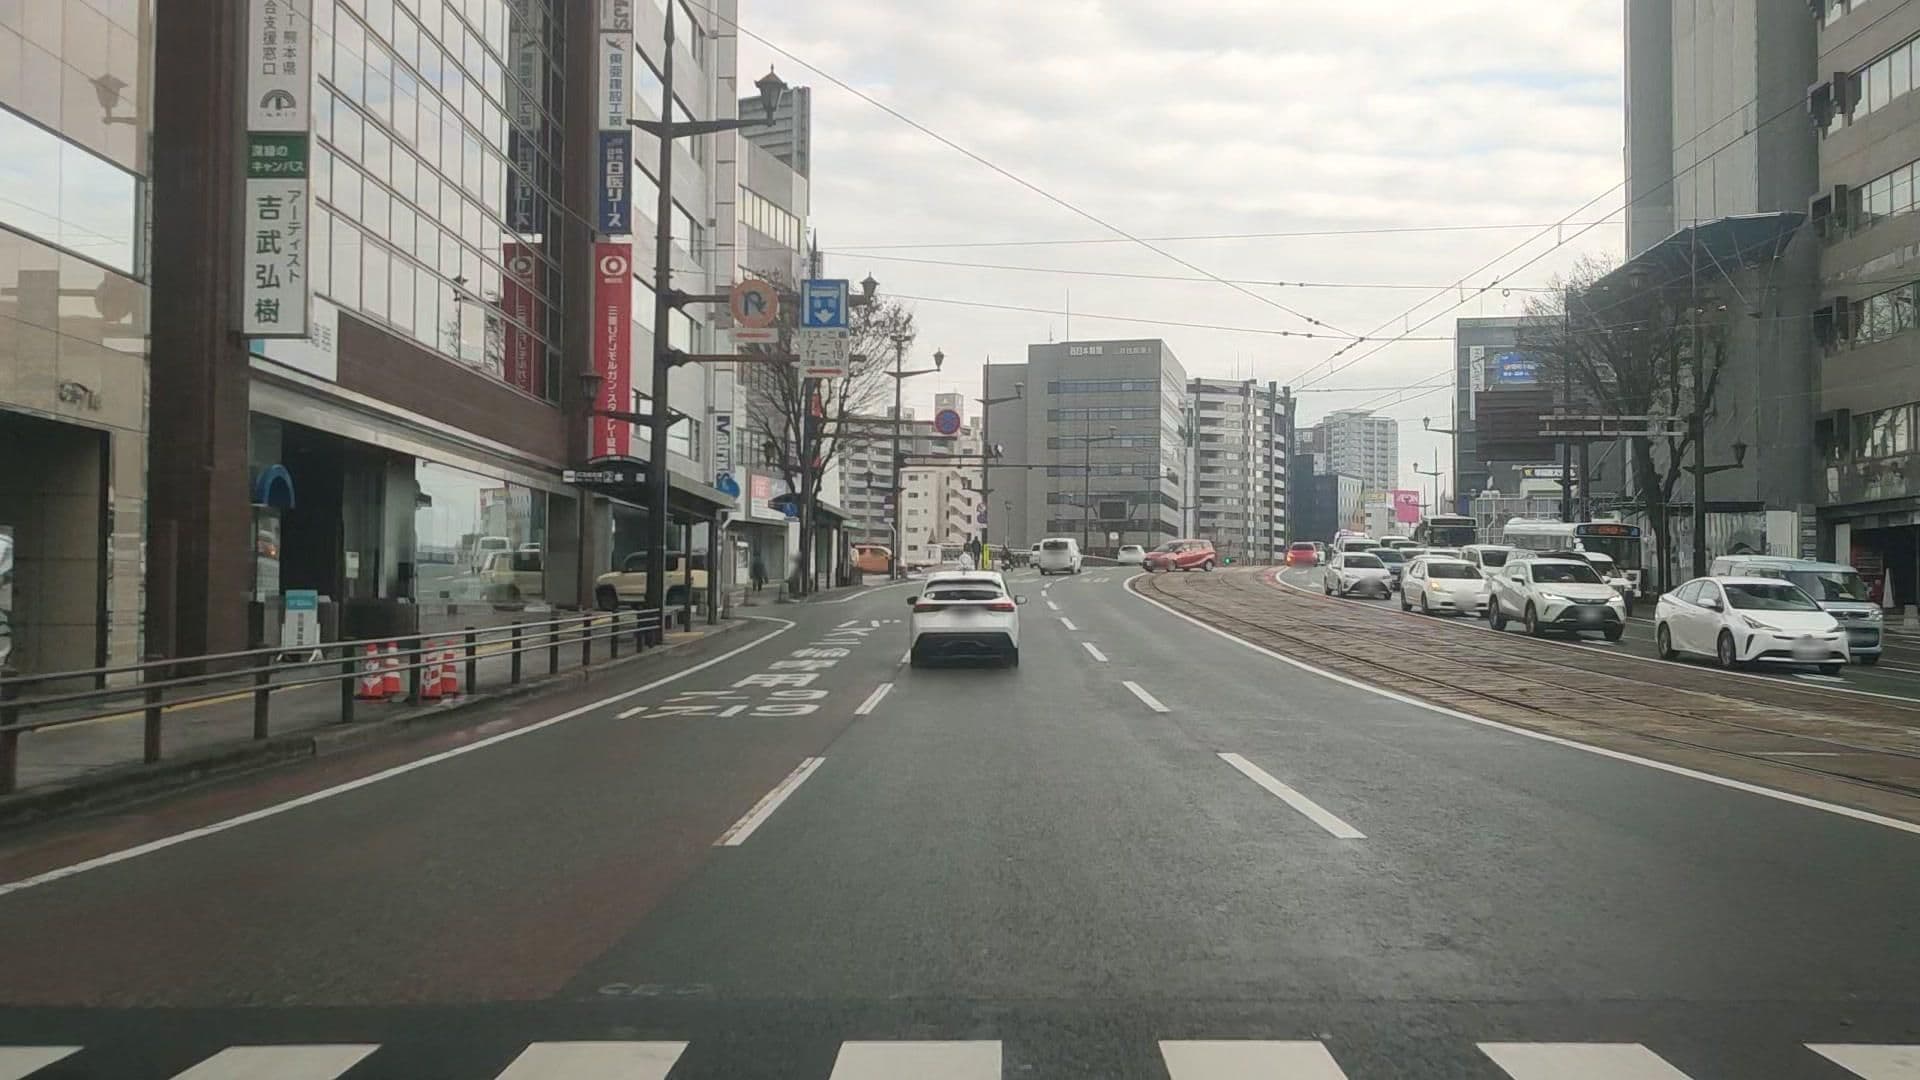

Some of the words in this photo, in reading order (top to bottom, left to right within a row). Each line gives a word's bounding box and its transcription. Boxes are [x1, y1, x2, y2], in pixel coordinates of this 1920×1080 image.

[254, 195, 283, 324] 吉武弘樹
[287, 189, 302, 284] アーティスト
